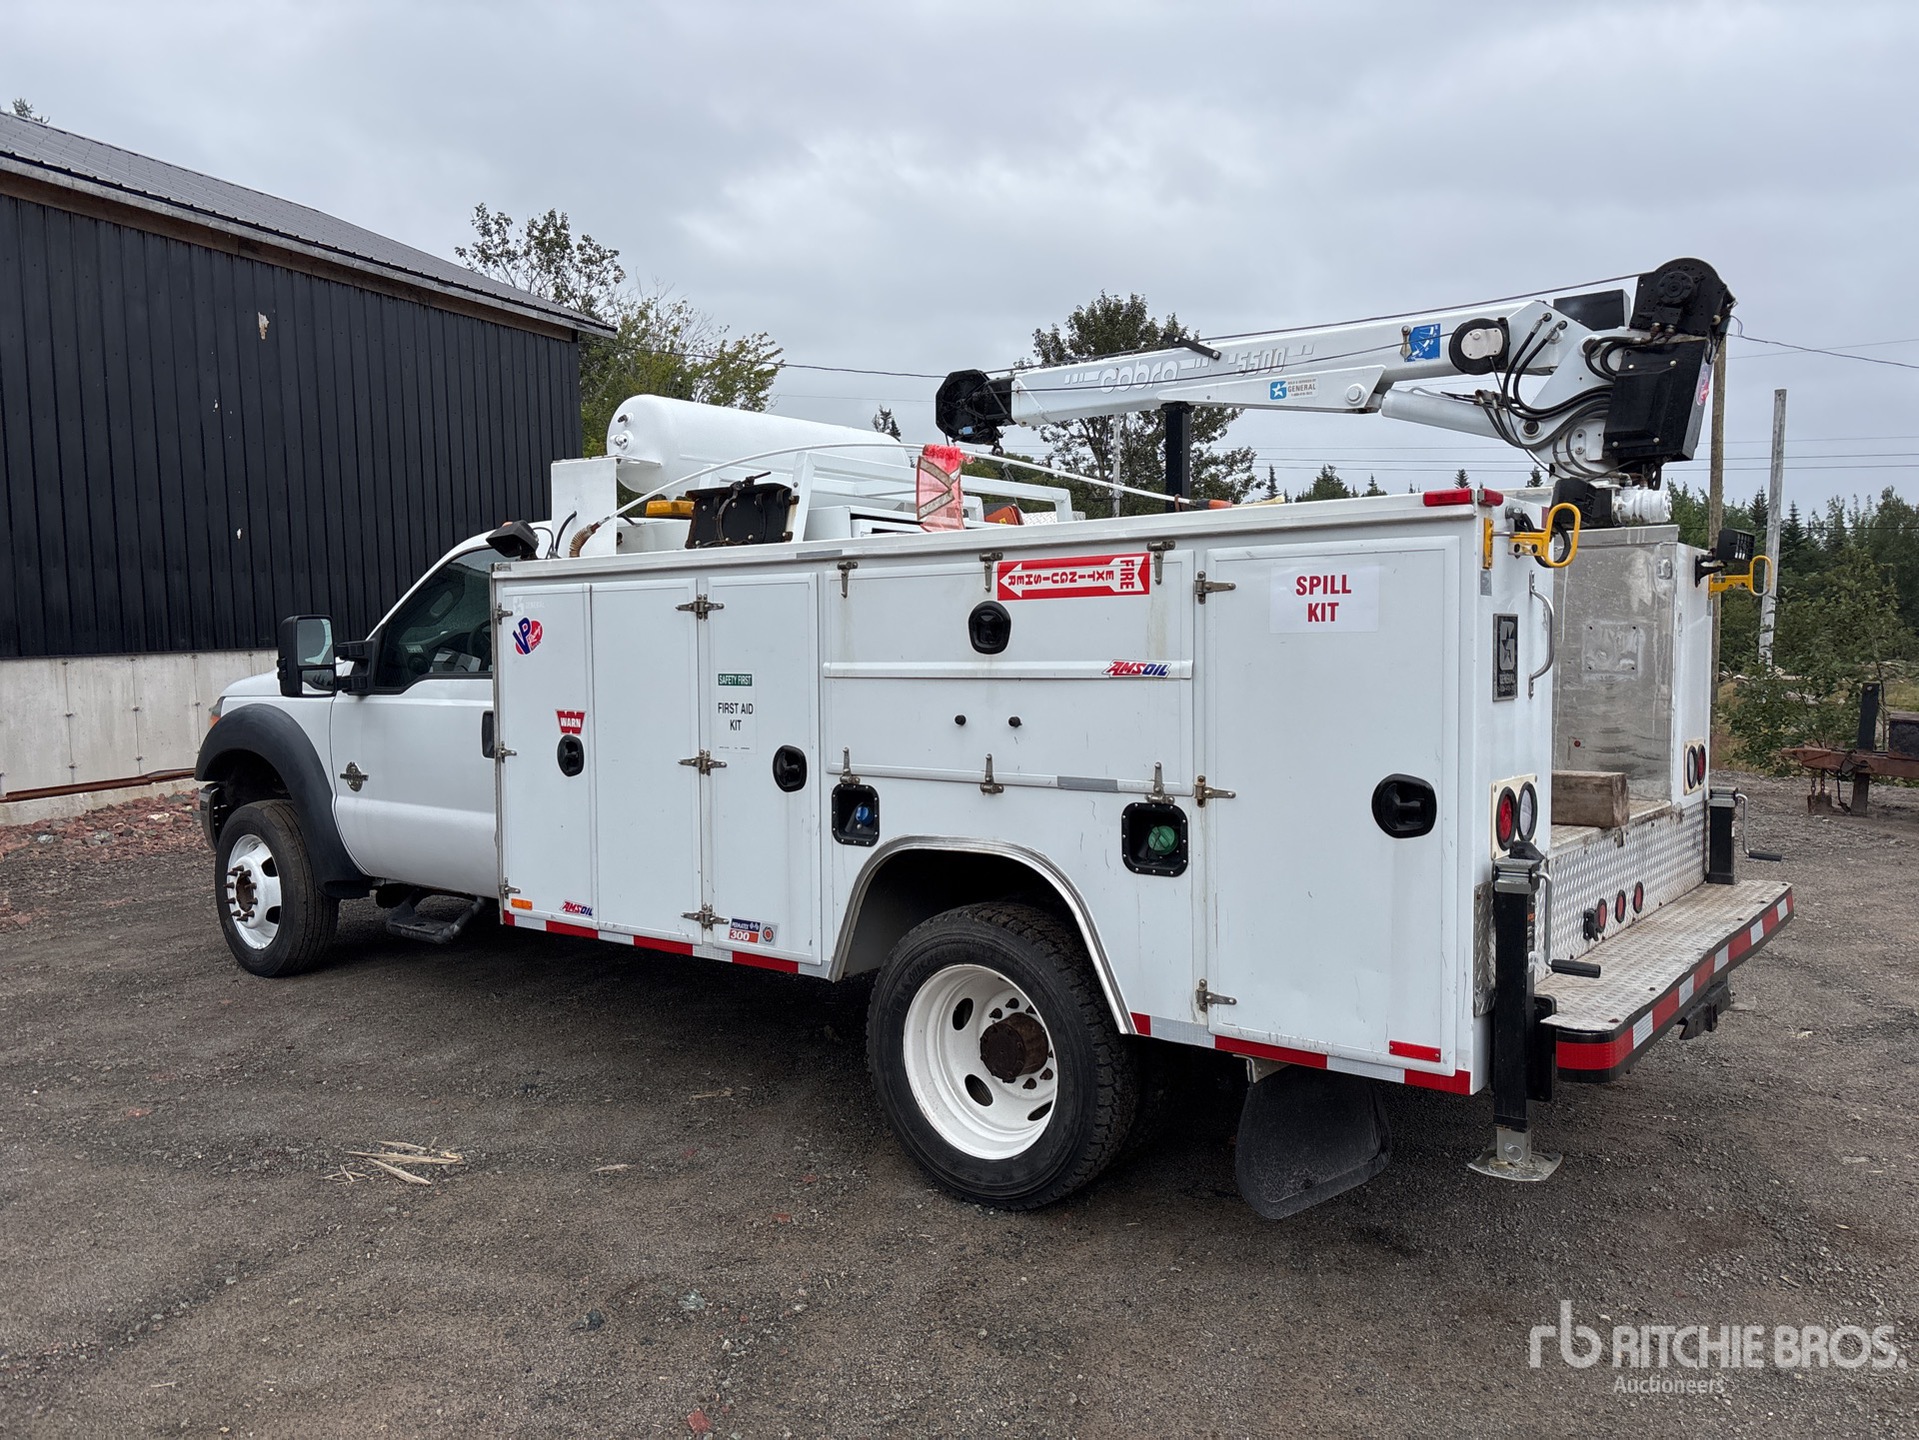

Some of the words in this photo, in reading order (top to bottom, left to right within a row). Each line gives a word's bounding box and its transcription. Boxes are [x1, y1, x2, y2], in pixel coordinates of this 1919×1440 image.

[1236, 347, 1287, 377] 5500
[1287, 383, 1316, 393] GENERAL
[1008, 569, 1115, 587] EXTINGUISHER
[1120, 559, 1134, 590] FIRE
[1295, 574, 1352, 596] SPILL
[1307, 602, 1340, 622] KIT
[512, 617, 531, 655] VP
[1106, 661, 1168, 676] AMSOIL
[719, 675, 737, 685] SAFETY
[738, 675, 752, 685] FIRST
[717, 702, 739, 714] FIRST
[740, 703, 754, 715] AID
[560, 717, 581, 728] WARN
[729, 720, 742, 731] KIT
[562, 901, 593, 916] AMSOIL
[730, 930, 750, 941] 300
